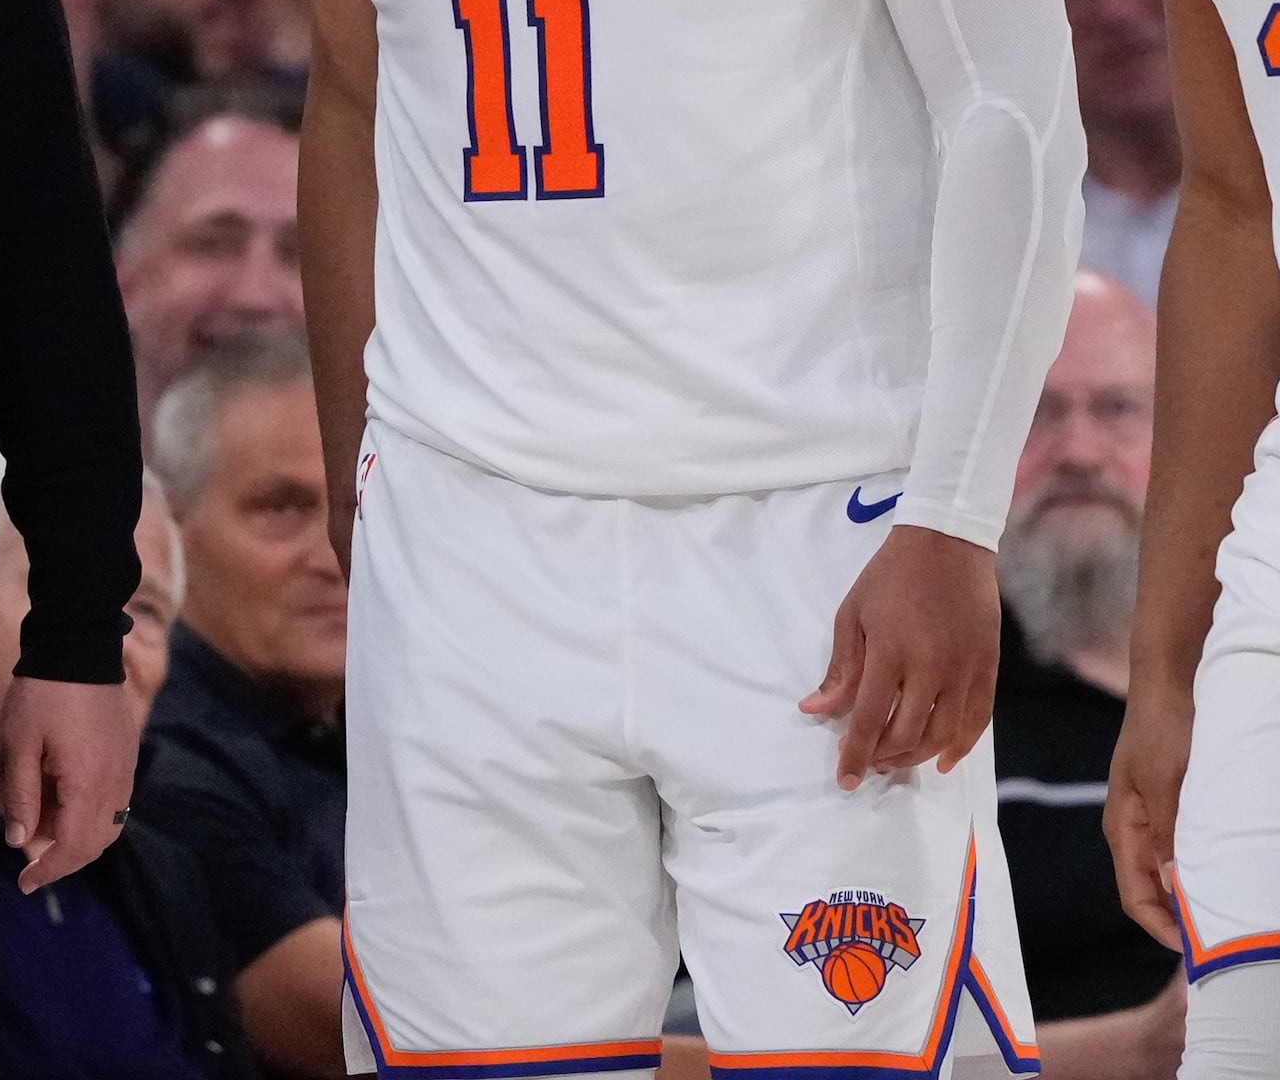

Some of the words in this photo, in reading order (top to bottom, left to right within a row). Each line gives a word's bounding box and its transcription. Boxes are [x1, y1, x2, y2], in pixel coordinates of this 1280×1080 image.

[829, 890, 854, 904] NEW
[856, 890, 885, 906] YORK
[784, 899, 922, 960] KNICKS
